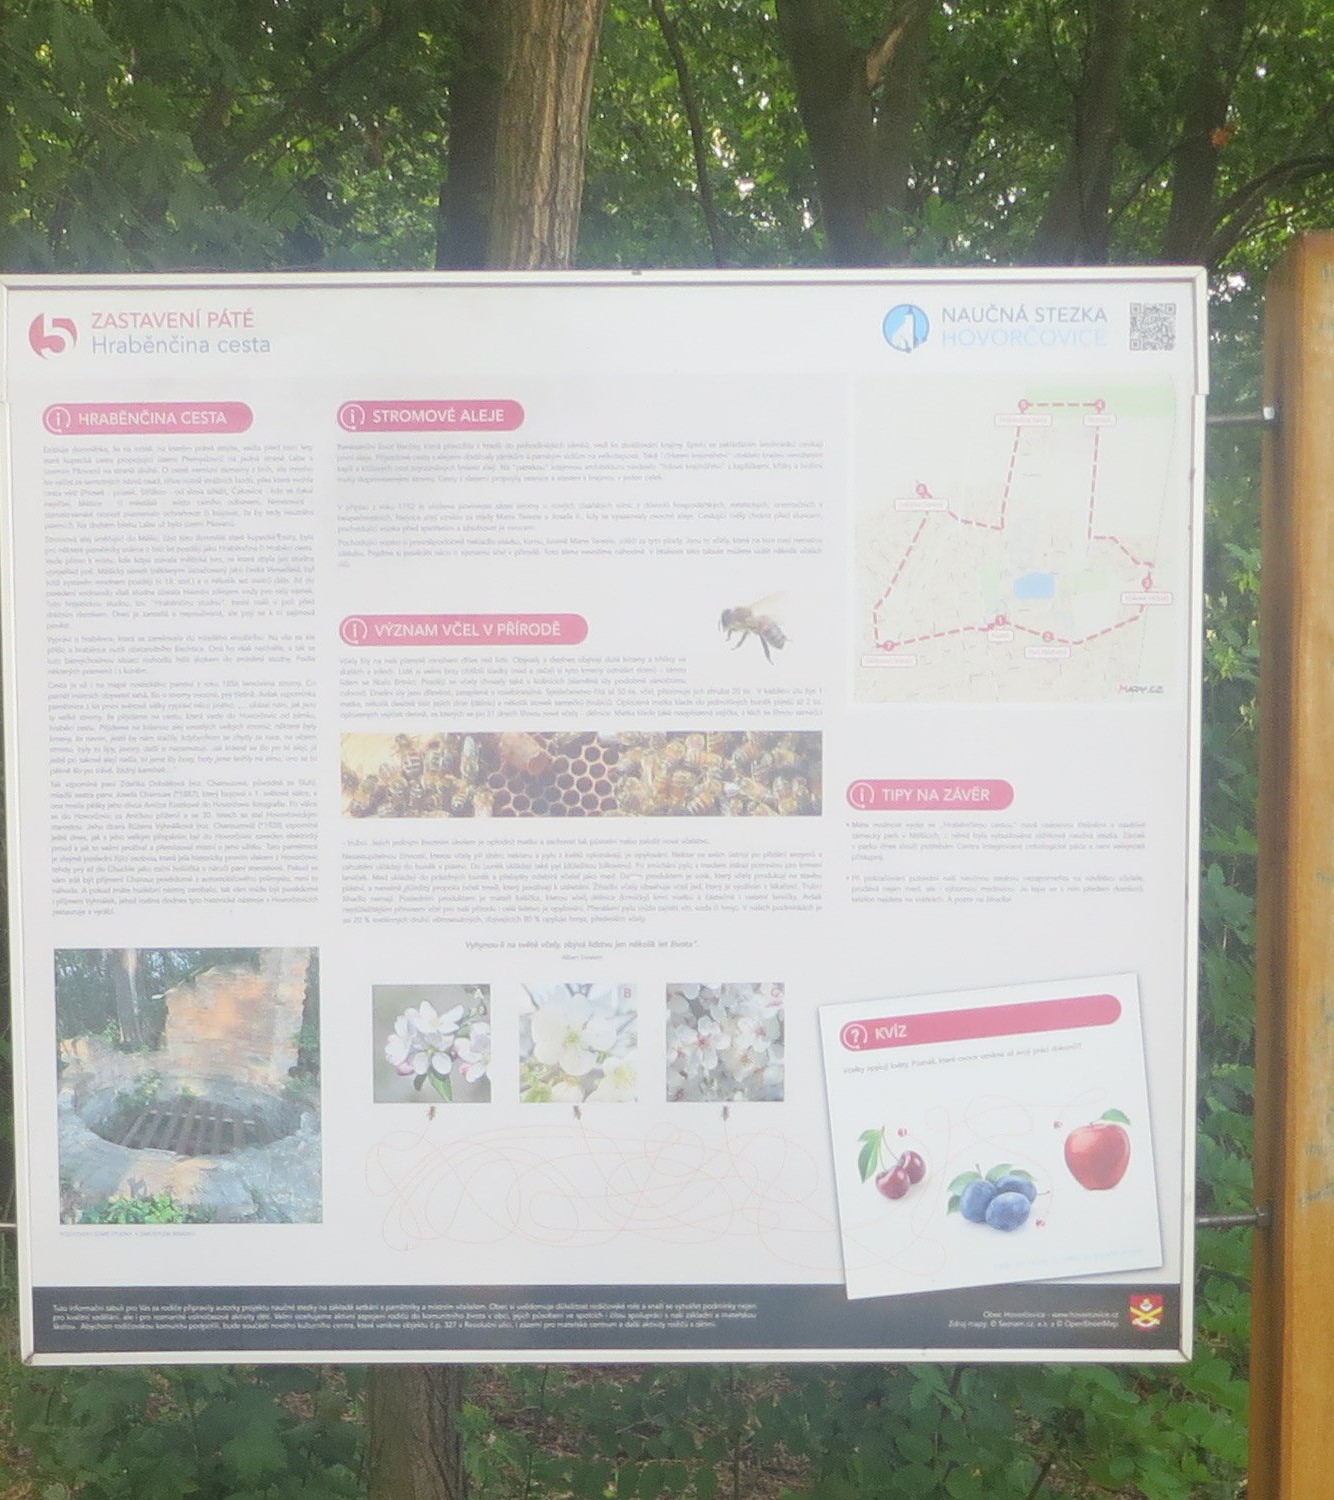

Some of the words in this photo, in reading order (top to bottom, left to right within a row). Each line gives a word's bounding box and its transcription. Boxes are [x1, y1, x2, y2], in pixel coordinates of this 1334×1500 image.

[91, 309, 200, 329] ZASTAVENÍ
[207, 308, 255, 328] PÁTÉ
[942, 304, 1028, 323] NAUČNÁ
[1035, 306, 1108, 323] STEZKA
[91, 335, 210, 354] Hraběnčina
[217, 337, 271, 353] cesta
[78, 408, 177, 425] HRABĚNČINA
[181, 411, 227, 425] CESTA
[373, 408, 455, 424] STROMOVÉ
[460, 409, 505, 423] ALEJE
[375, 621, 438, 637] VÝZNAM
[443, 621, 479, 637] VČEL
[485, 624, 494, 636] V
[497, 620, 561, 637] PŘÍRODĚ
[882, 788, 914, 801] TIPY
[917, 788, 939, 801] NA
[943, 785, 991, 801] ZÁVĚR
[875, 1023, 907, 1040] KVÍZ
